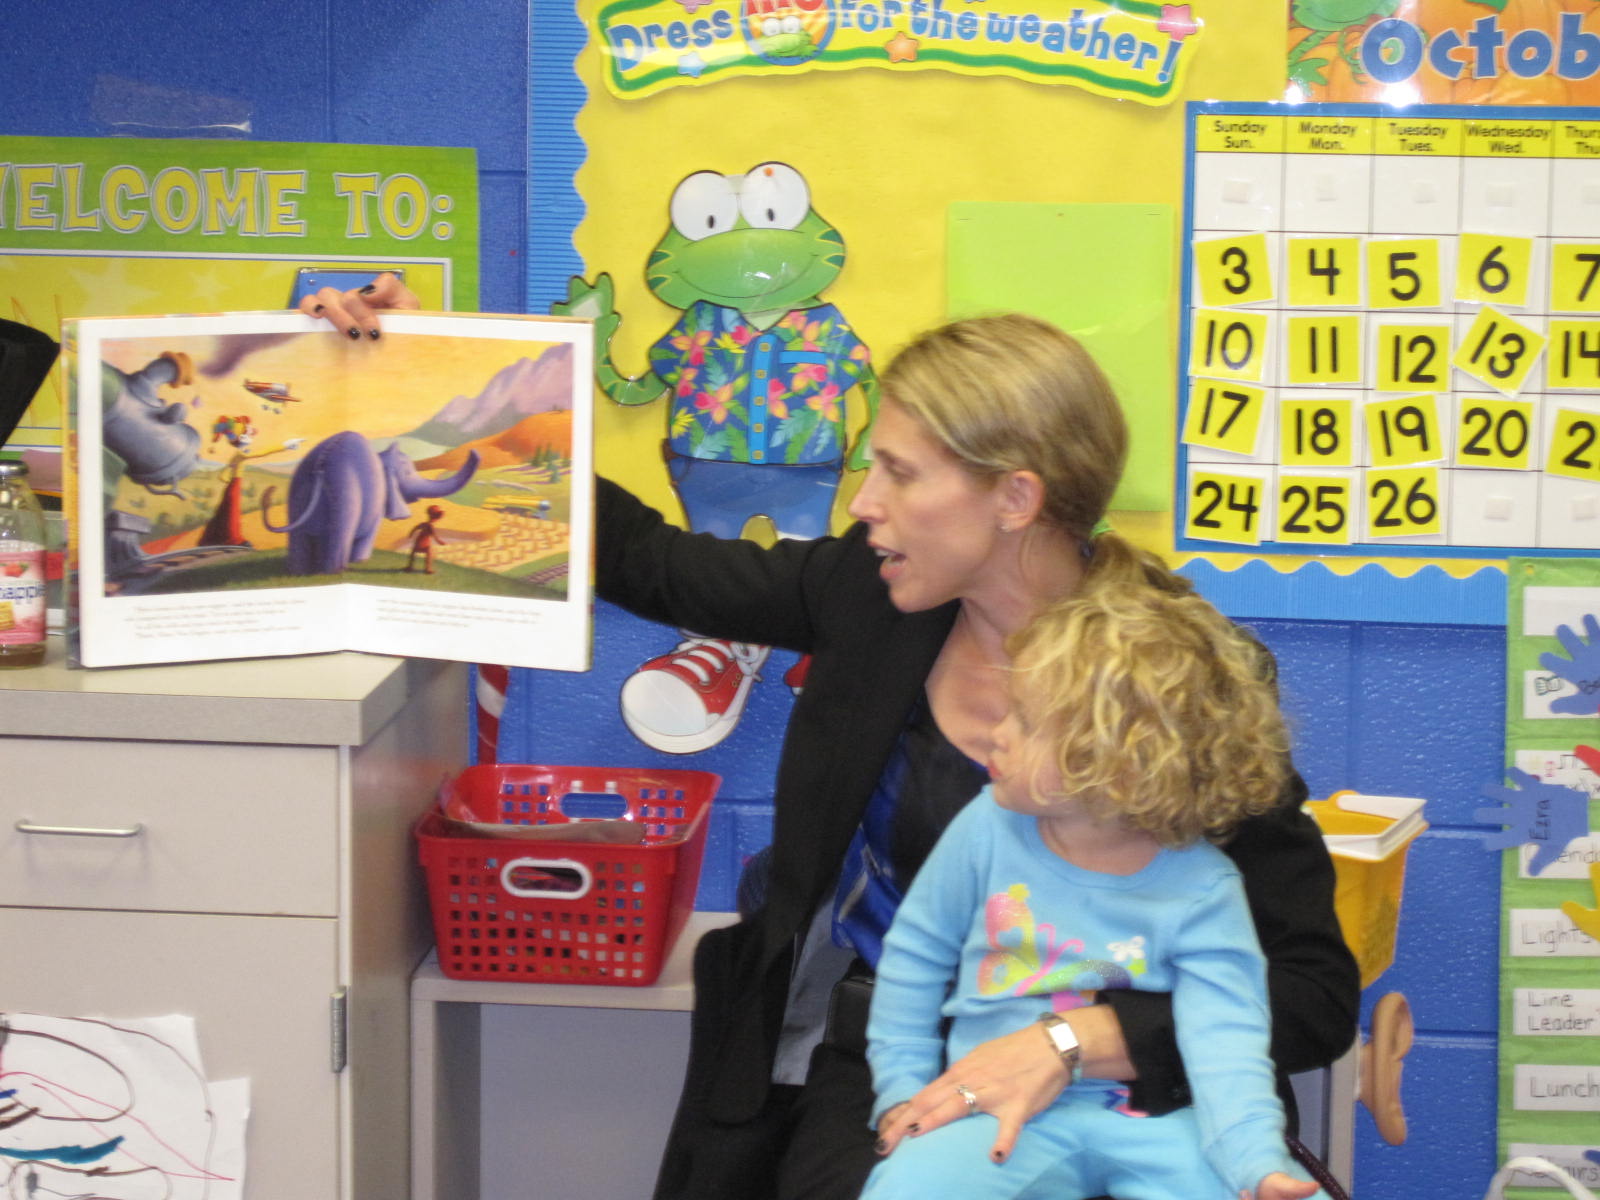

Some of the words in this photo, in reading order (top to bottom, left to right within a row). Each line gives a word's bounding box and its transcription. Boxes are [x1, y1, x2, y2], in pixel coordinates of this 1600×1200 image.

[606, 9, 733, 72] Dress
[840, 0, 902, 32] for
[910, 0, 978, 40] the
[985, 9, 1184, 83] weather!
[1360, 12, 1600, 84] Octob
[1214, 120, 1267, 136] Sunday
[1224, 136, 1254, 149] Sun.
[1300, 121, 1357, 137] Monday
[1310, 138, 1344, 150] Mon.
[1388, 122, 1447, 139] Tuesday
[1400, 139, 1433, 152] Tues.
[1465, 124, 1550, 140] Wednesday
[1488, 141, 1525, 153] Wed.
[334, 172, 454, 240] TO:
[1221, 247, 1251, 294] 3
[1309, 248, 1340, 295] 4
[1390, 252, 1420, 300] 5
[1478, 246, 1509, 293] 6
[1576, 254, 1600, 301] 7
[1206, 320, 1253, 369] 10
[1311, 326, 1337, 373] 11
[1394, 335, 1436, 383] 12
[1471, 322, 1525, 378] 13
[1200, 388, 1250, 438] 17
[1296, 408, 1339, 455] 18
[1381, 406, 1428, 457] 19
[1462, 408, 1527, 457] 20
[1193, 480, 1257, 532] 24
[1283, 485, 1345, 533] 25
[1371, 477, 1436, 527] 26
[1528, 991, 1574, 1007] Line
[1528, 1012, 1594, 1031] Leader
[1530, 1072, 1600, 1098] Lunch
